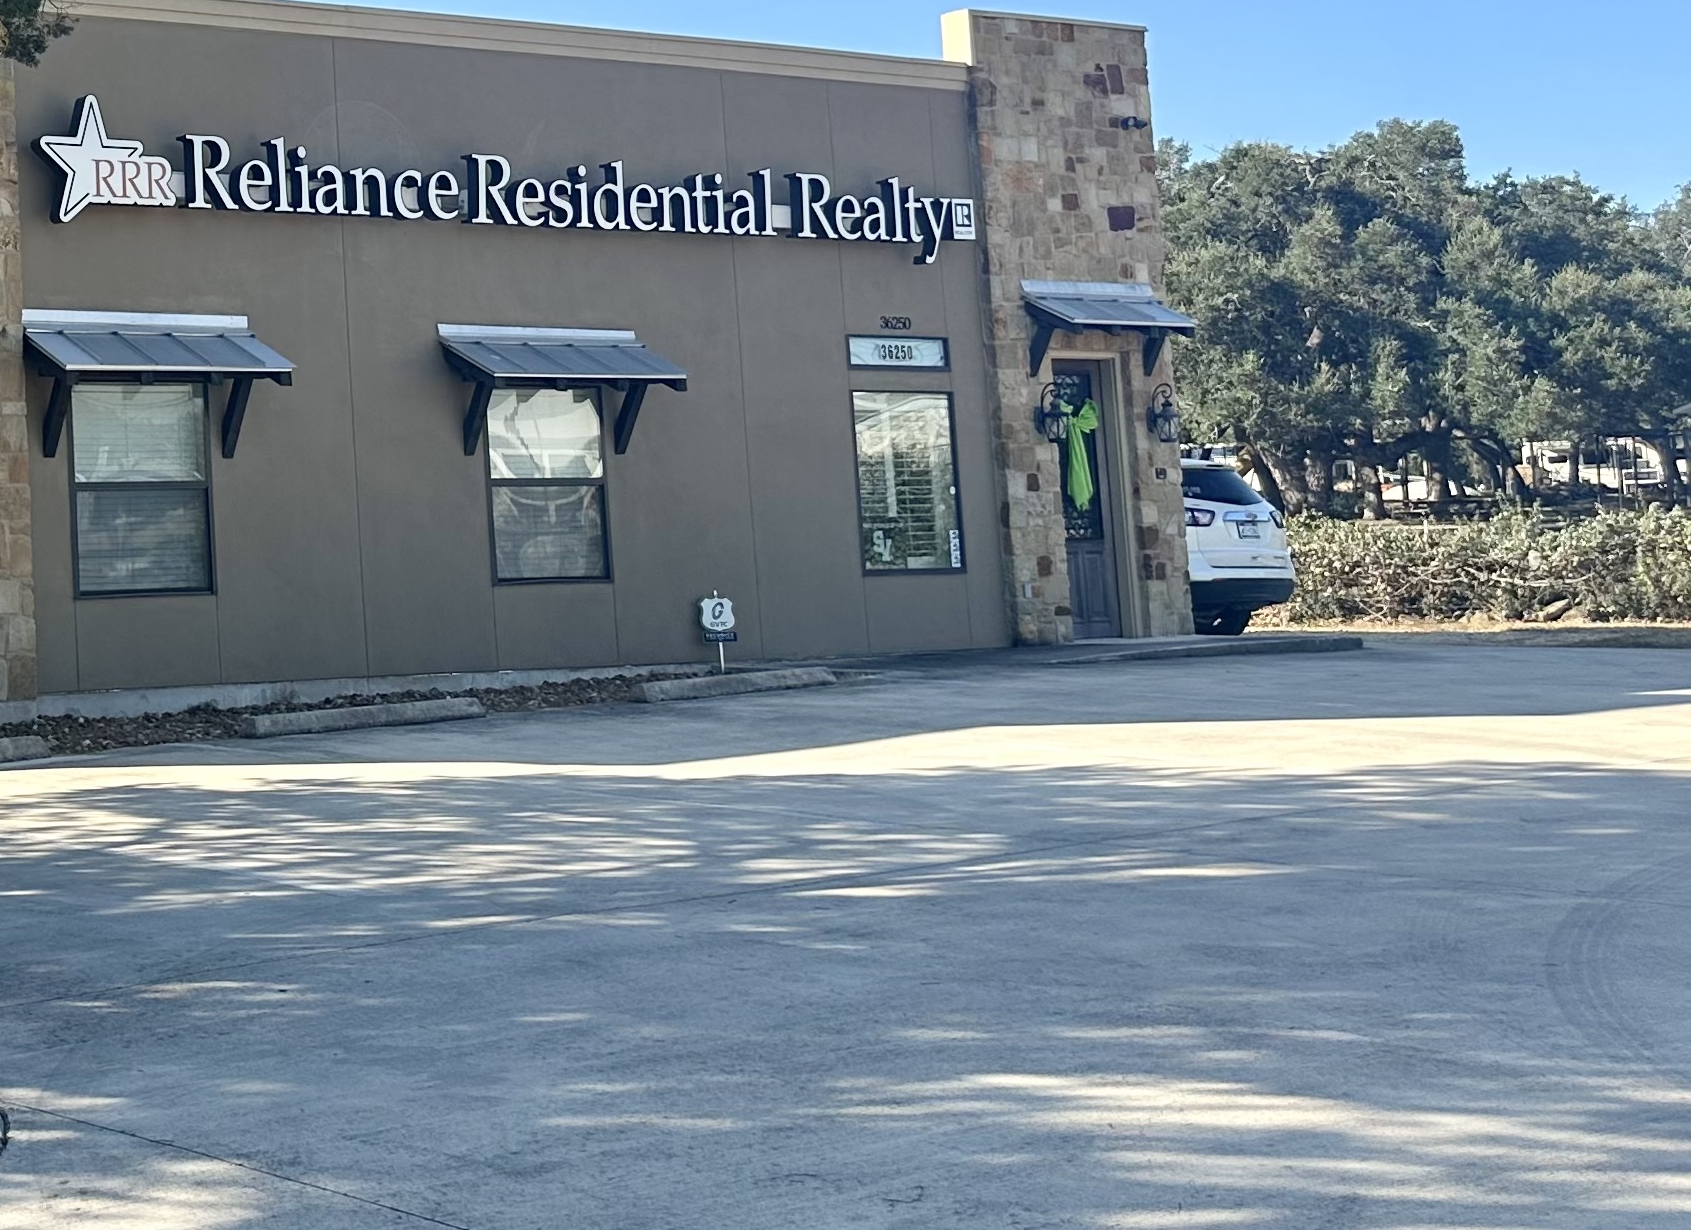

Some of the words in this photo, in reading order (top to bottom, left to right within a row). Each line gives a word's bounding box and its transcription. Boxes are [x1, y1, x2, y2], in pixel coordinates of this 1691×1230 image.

[91, 158, 171, 200] RRR
[185, 134, 460, 220] Reliance
[471, 153, 778, 236] Residential
[795, 173, 951, 264] Realty
[879, 315, 912, 330] 36250
[880, 344, 913, 360] 36250
